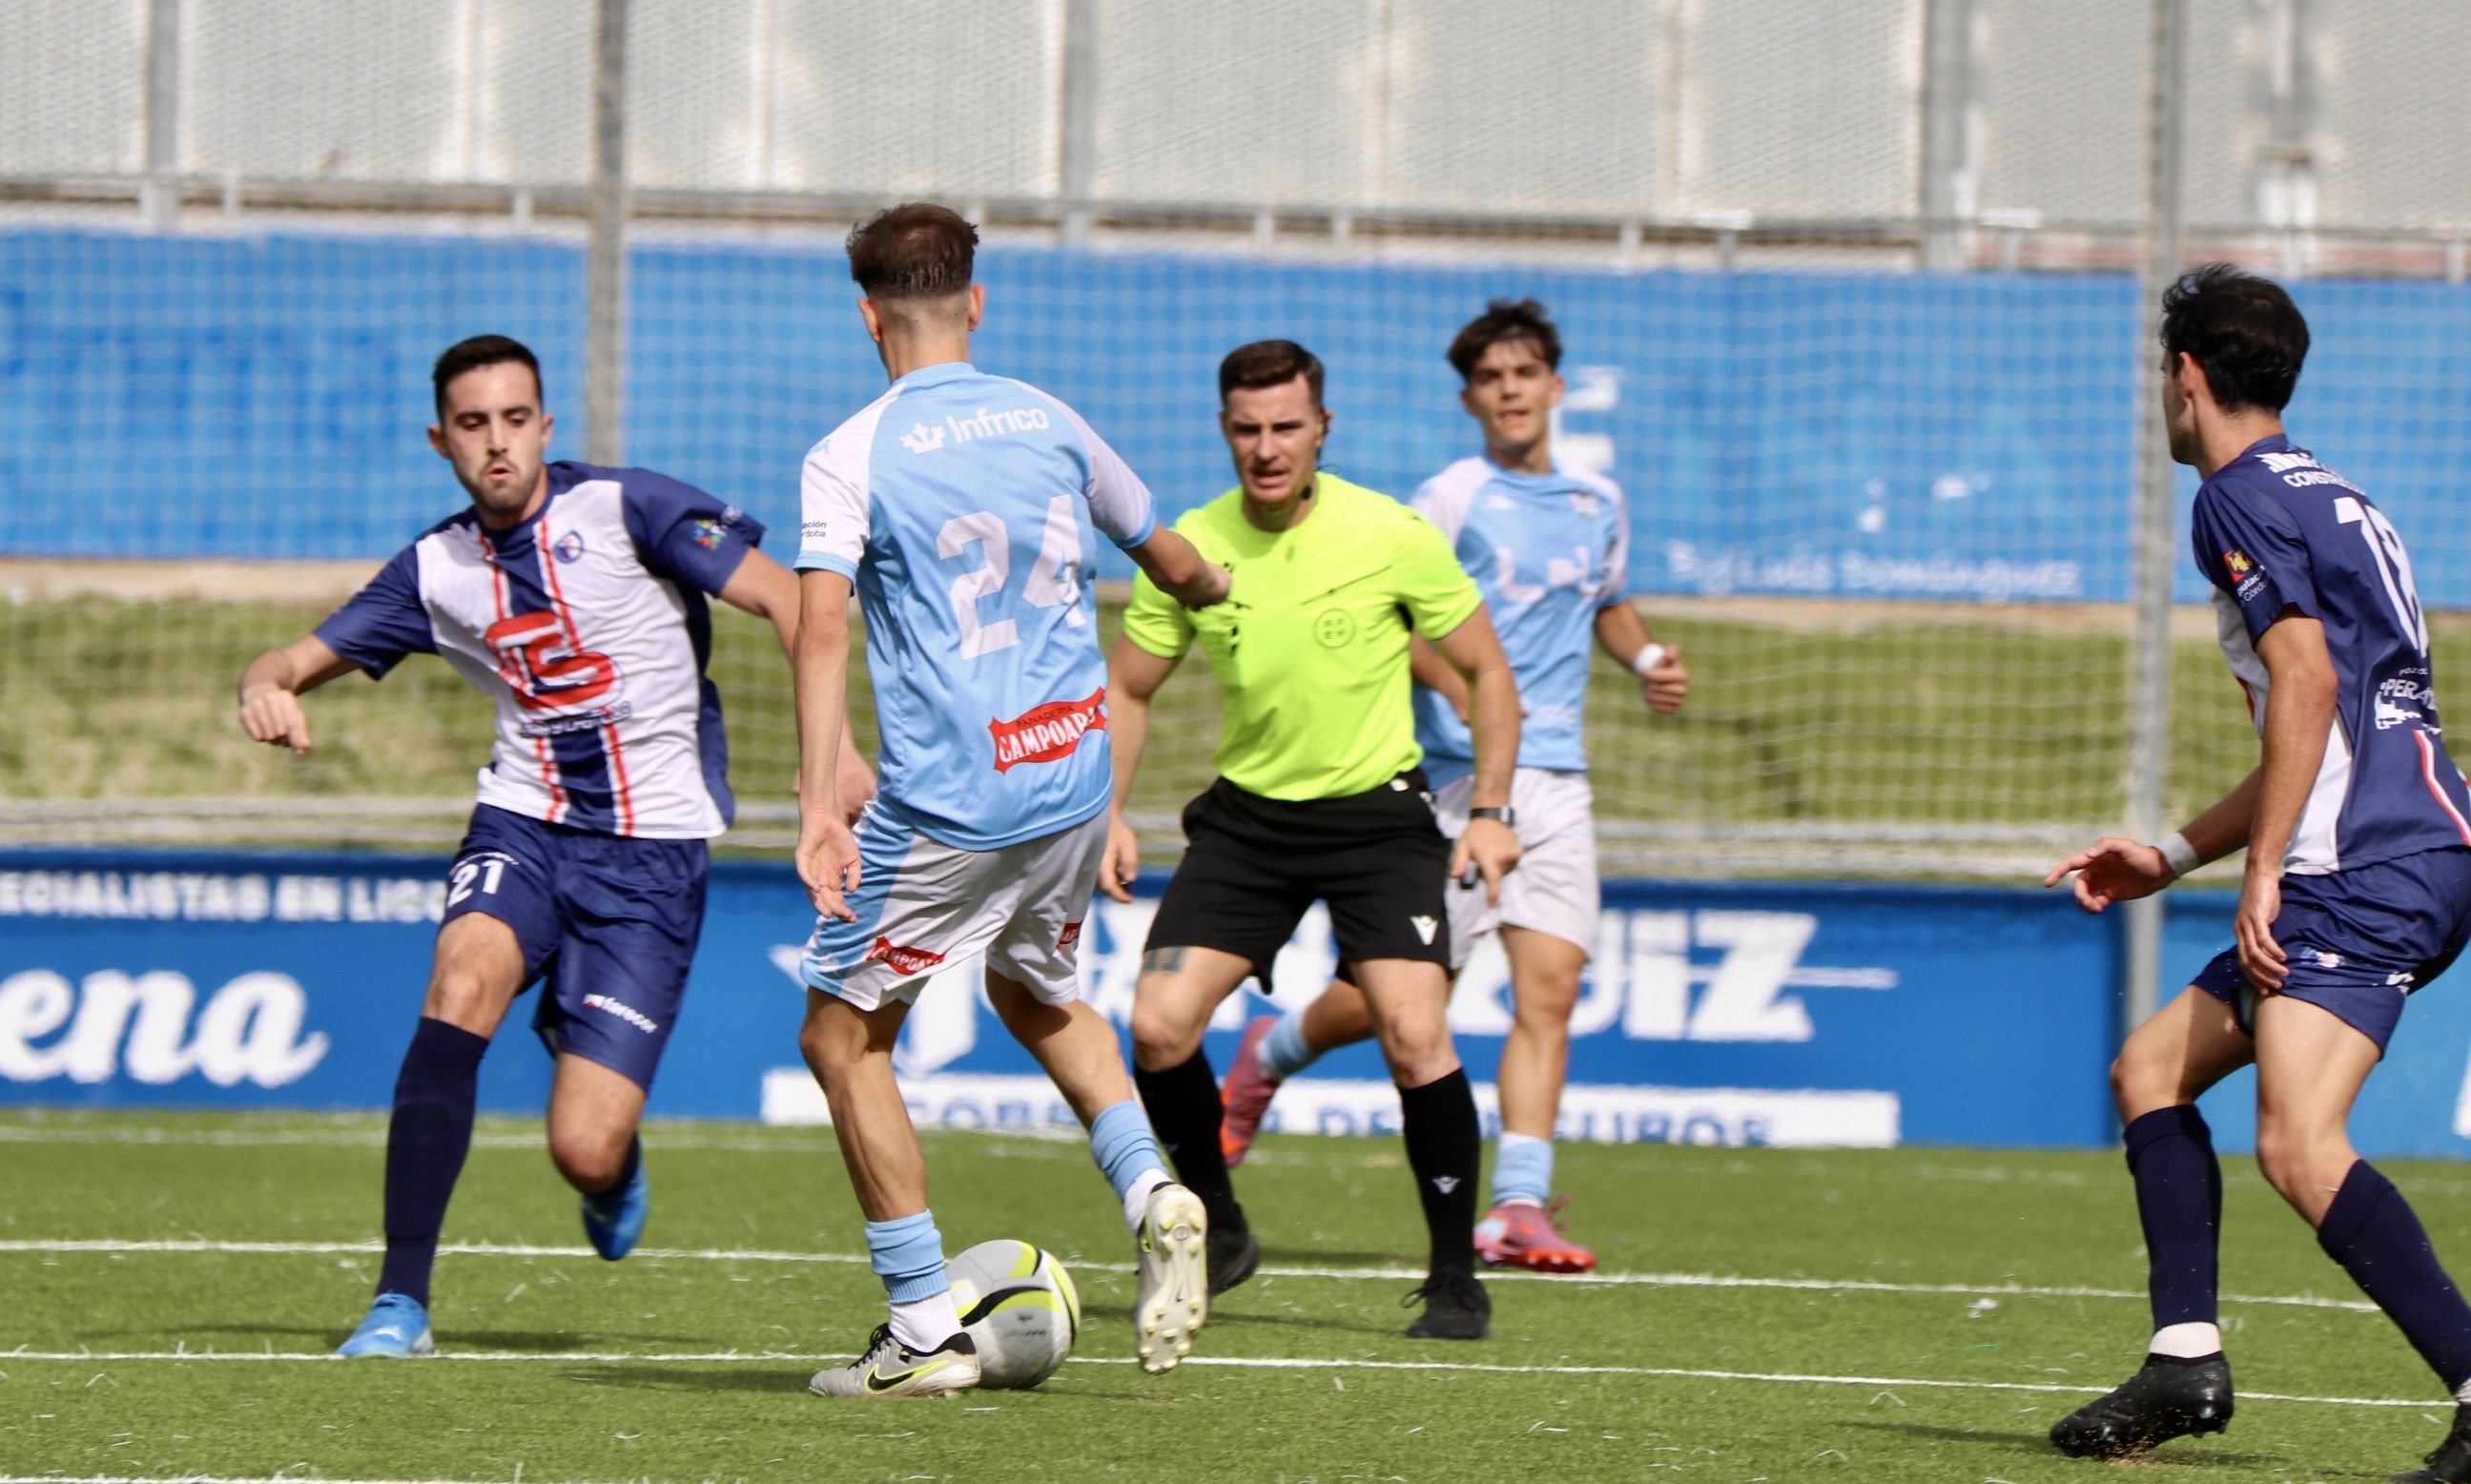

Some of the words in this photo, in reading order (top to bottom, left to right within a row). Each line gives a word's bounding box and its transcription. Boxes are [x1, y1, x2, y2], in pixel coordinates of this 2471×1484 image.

[946, 407, 1050, 443] Infrico
[937, 494, 1086, 660] 24
[273, 874, 341, 922] EN
[446, 859, 504, 908] 21
